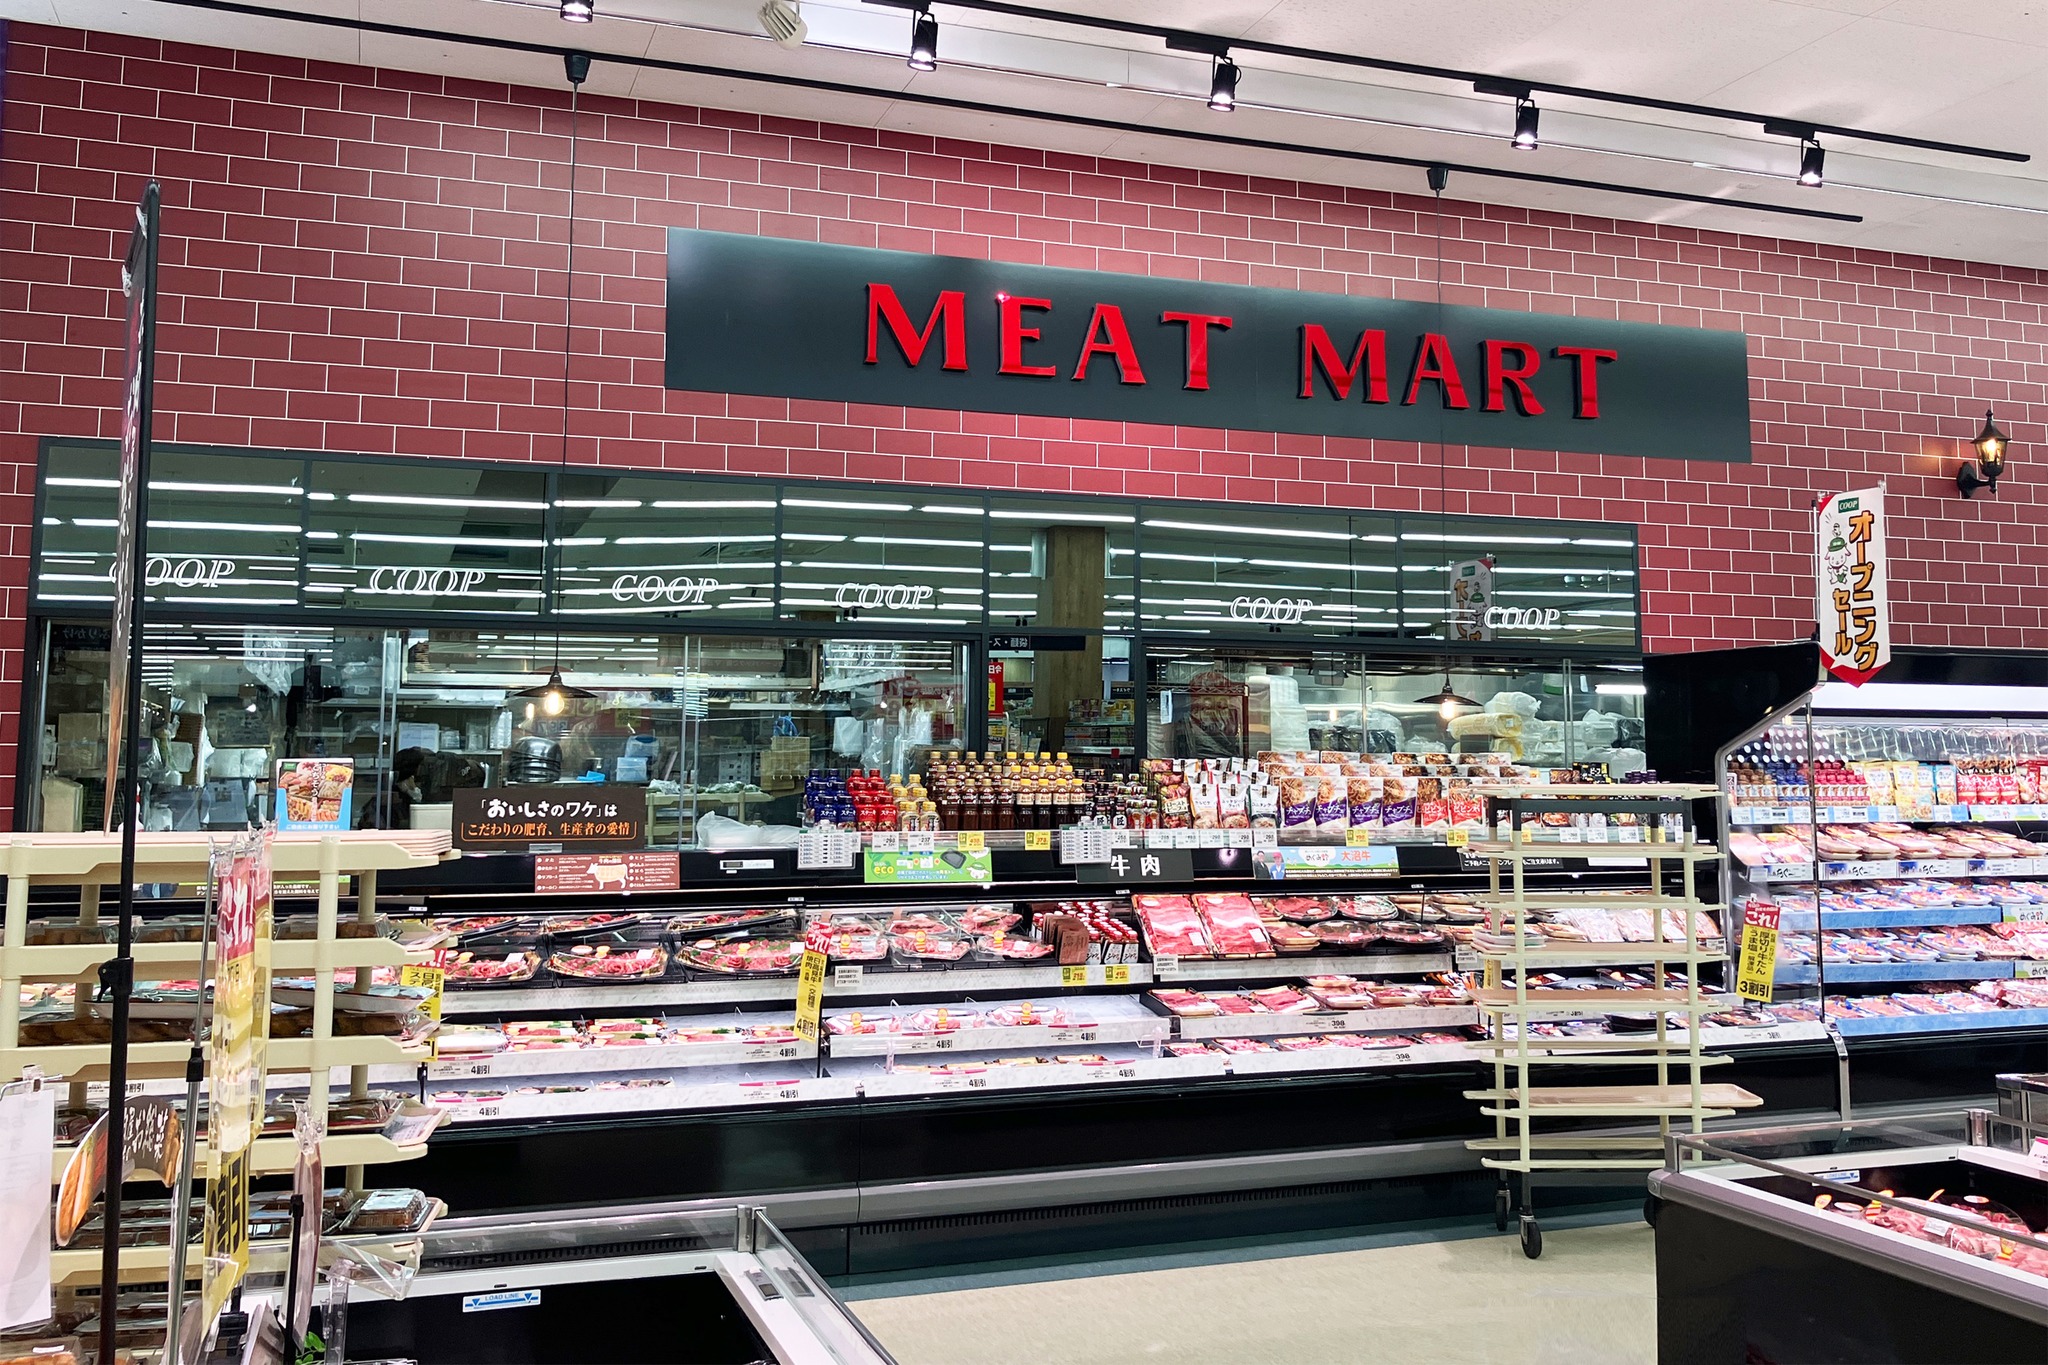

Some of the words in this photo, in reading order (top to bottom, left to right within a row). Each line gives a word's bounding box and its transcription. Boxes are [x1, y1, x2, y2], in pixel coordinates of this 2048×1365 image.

[864, 282, 1232, 391] MEAT
[1299, 322, 1619, 420] MART
[1839, 500, 1858, 510] COOP
[369, 566, 486, 595] COOP
[611, 574, 719, 604] COOP
[1849, 510, 1879, 672] オープニング
[835, 582, 934, 610] COOP
[1229, 596, 1313, 624] COOP
[1483, 605, 1561, 631] COOP
[1832, 587, 1853, 657] セール
[481, 798, 618, 818] 「おいしさのワケ」は
[467, 822, 631, 837] こだわりの肥育、生産者の愛情
[1110, 854, 1161, 877] 牛肉
[1341, 850, 1371, 862] 大沼牛
[873, 866, 894, 874] eco
[1740, 980, 1770, 998] 3割引
[471, 1065, 491, 1075] 4割引
[479, 1106, 500, 1116] 4割引
